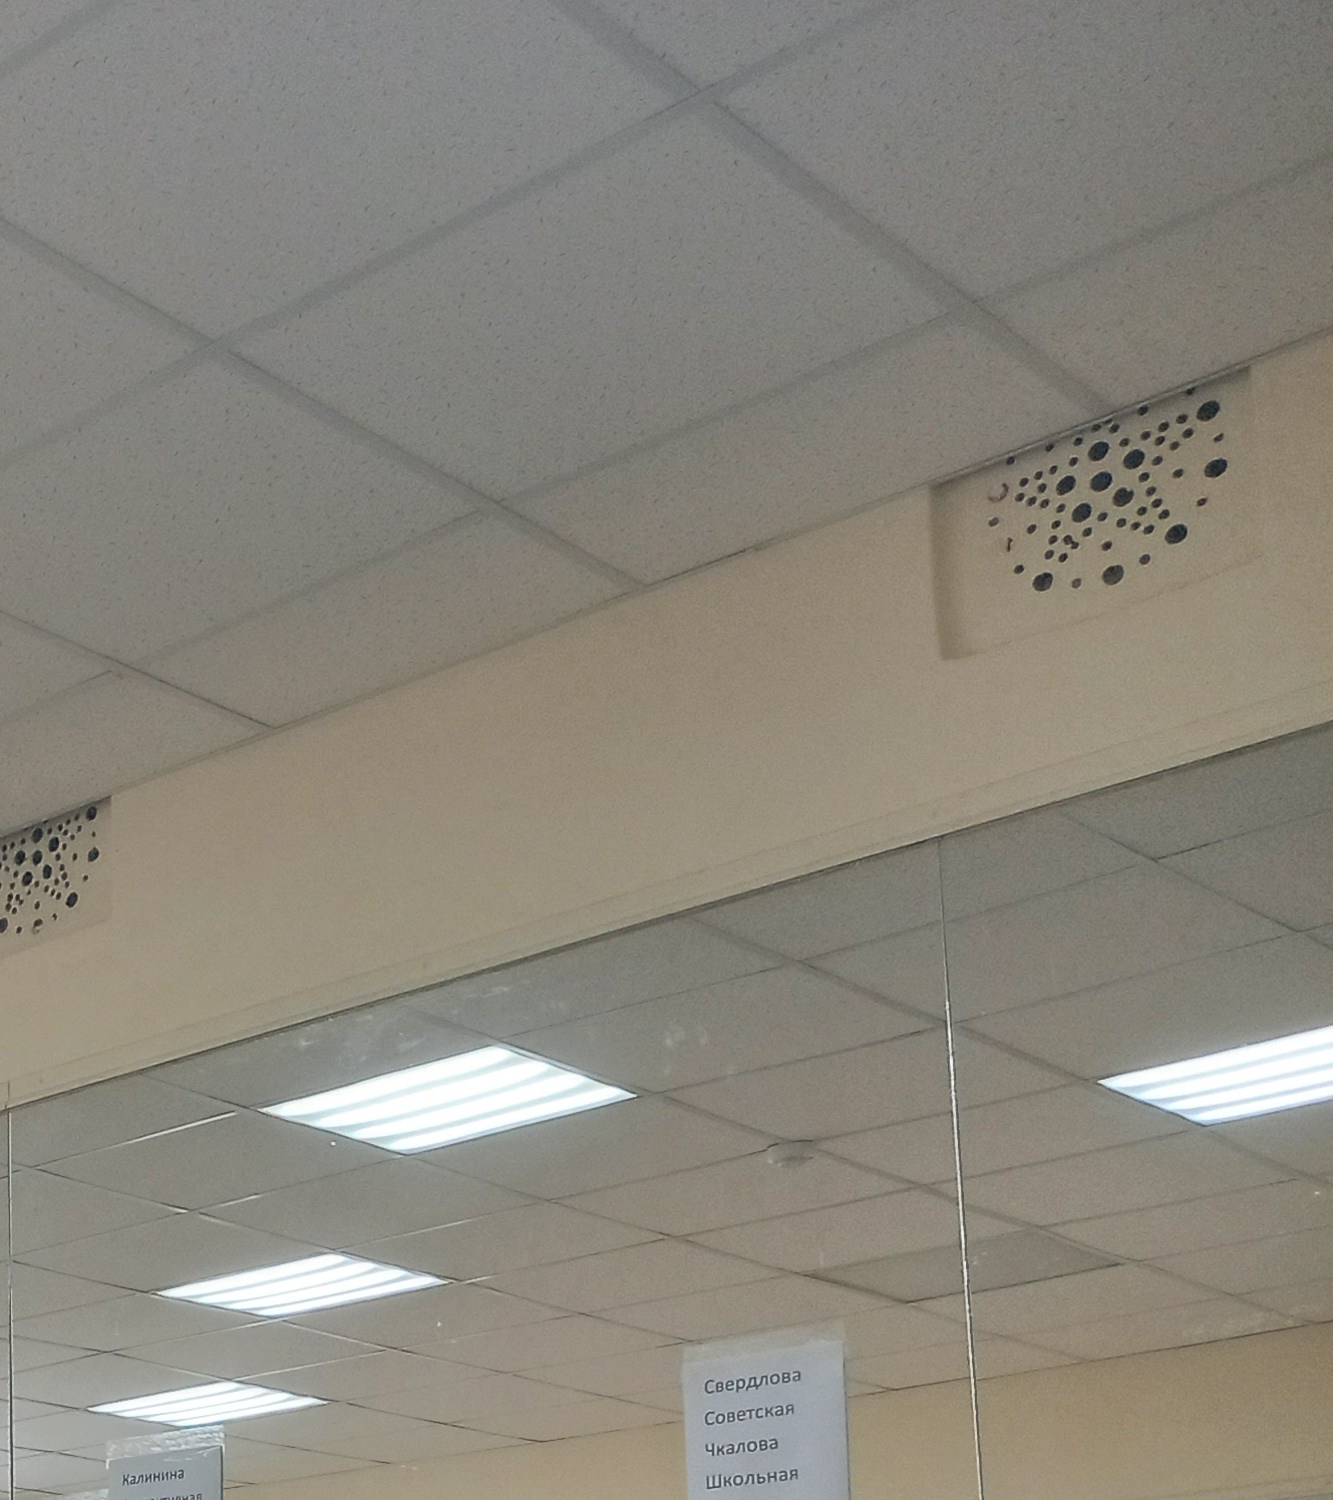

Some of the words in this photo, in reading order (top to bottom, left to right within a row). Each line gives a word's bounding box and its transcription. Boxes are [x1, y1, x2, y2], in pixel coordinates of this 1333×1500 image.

[704, 1370, 802, 1395] Свердлова
[704, 1403, 795, 1426] Советская
[705, 1438, 779, 1457] Чкалова
[122, 1469, 184, 1486] Калинина
[706, 1468, 799, 1490] Школьная
